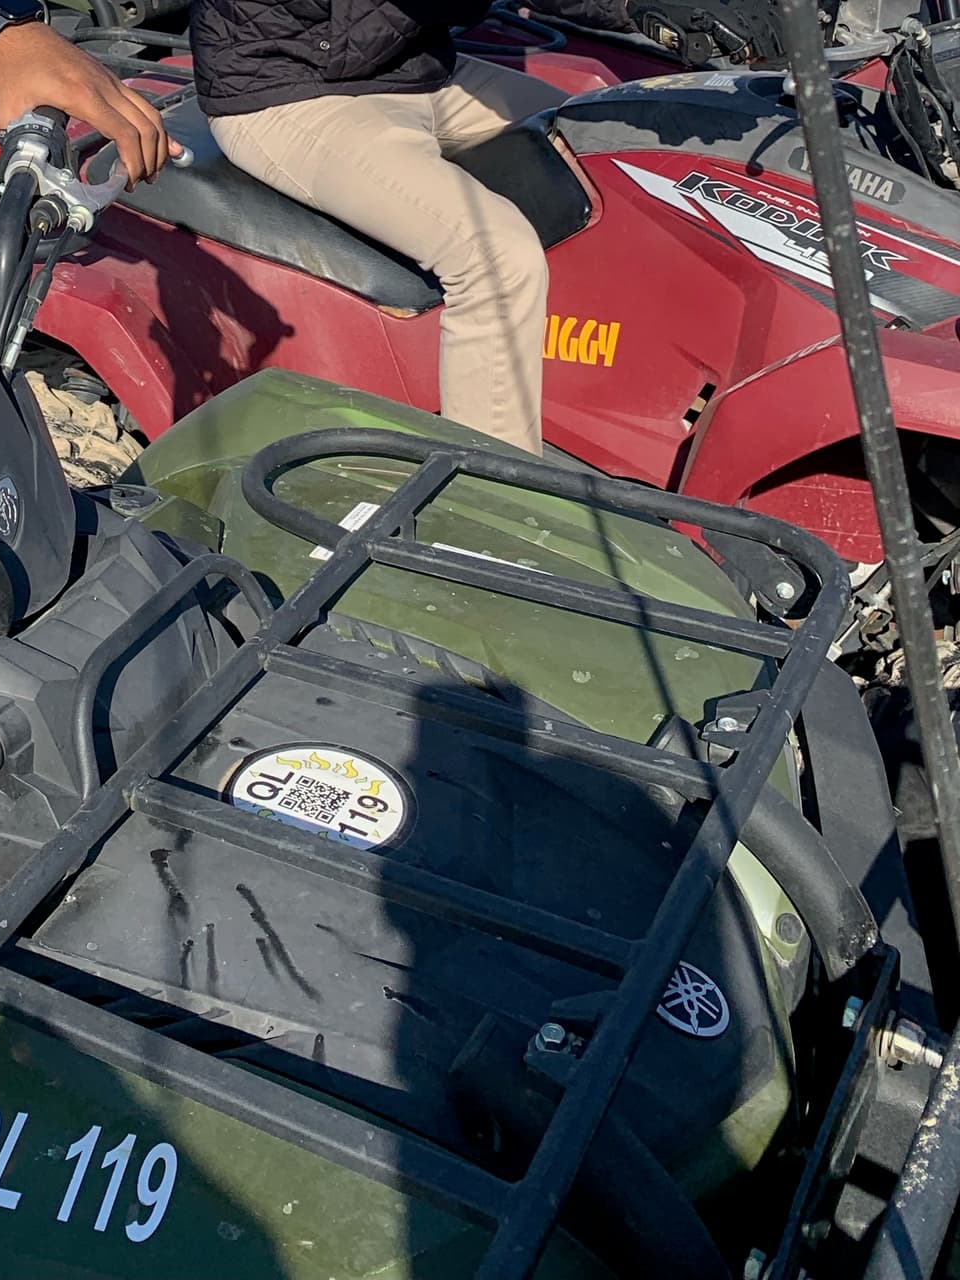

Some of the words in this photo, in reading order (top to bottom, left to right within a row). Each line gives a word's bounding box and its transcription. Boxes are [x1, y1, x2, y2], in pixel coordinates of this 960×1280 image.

[673, 170, 910, 272] KODIK
[756, 190, 794, 208] FUEL
[542, 314, 620, 368] UGGY
[246, 771, 295, 801] QL
[338, 794, 390, 837] 119
[56, 1125, 178, 1243] 119
